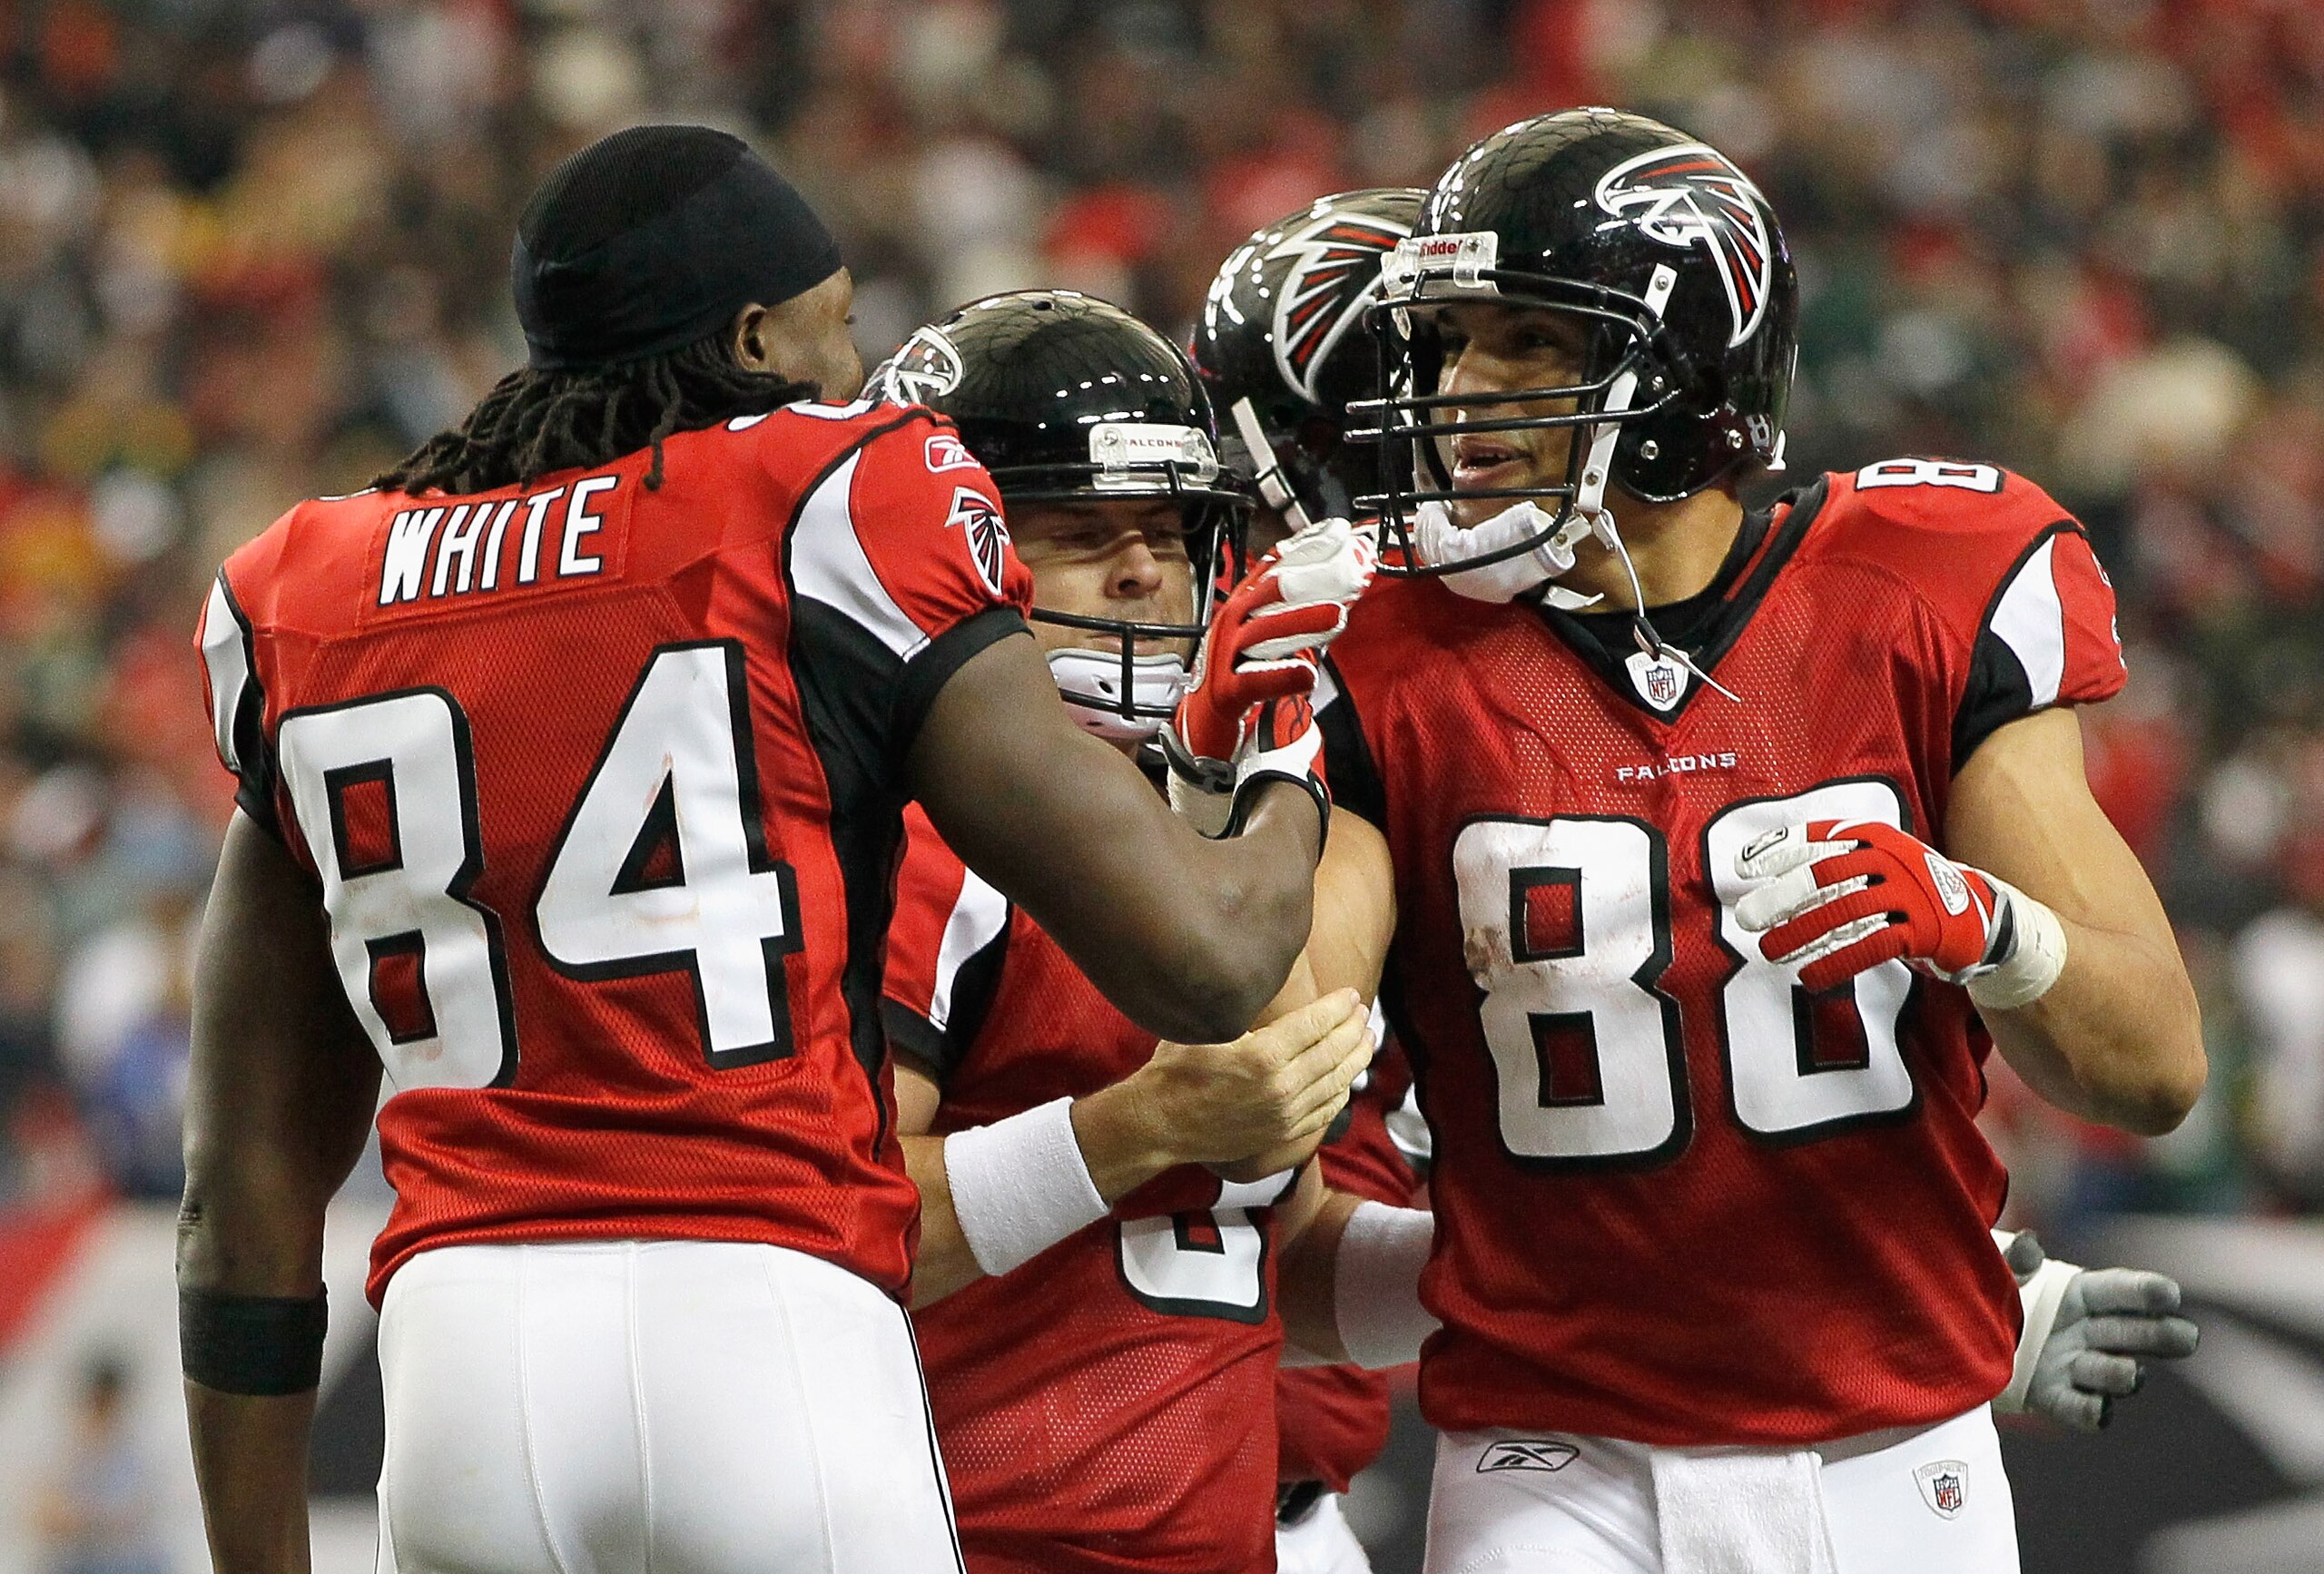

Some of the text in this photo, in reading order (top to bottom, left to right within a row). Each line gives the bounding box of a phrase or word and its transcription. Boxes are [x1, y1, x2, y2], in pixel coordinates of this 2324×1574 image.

[378, 475, 621, 606] WHITE
[1616, 752, 1736, 782] FALCONS
[279, 639, 801, 1089] 84
[1453, 777, 1919, 1165] 88
[1937, 1488, 1962, 1509] NFL
